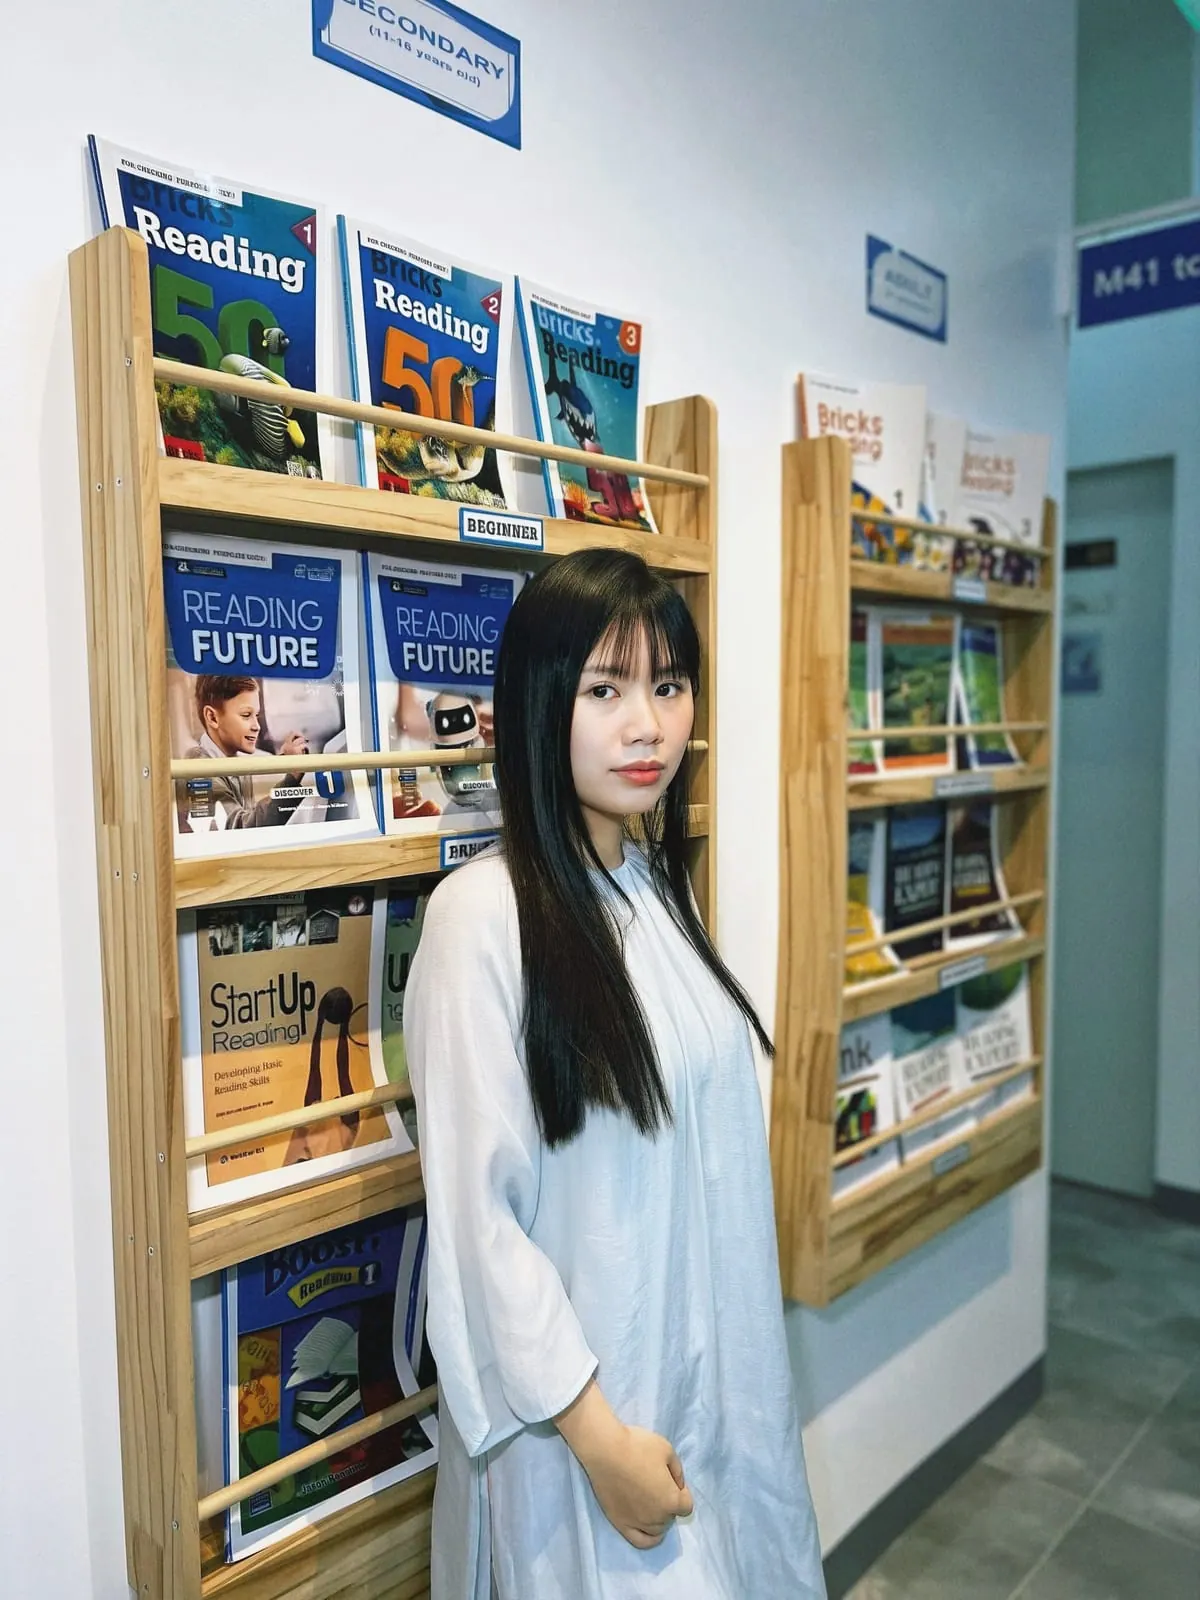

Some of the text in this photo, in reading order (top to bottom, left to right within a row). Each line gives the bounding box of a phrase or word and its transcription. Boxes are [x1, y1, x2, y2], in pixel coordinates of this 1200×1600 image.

[415, 48, 453, 71] years
[456, 69, 481, 88] old)
[121, 158, 136, 170] FOR
[137, 164, 173, 182] CHECKING
[132, 205, 306, 294] Reading
[303, 223, 312, 245] 1
[380, 241, 407, 256] CHECKING
[1093, 256, 1160, 298] M41
[372, 278, 490, 354] Reading
[488, 297, 499, 315] 2
[625, 325, 637, 347] 3
[541, 328, 635, 389] Reading
[818, 402, 883, 436] Bricks
[467, 518, 538, 541] BEGINNER
[183, 589, 323, 632] READING
[396, 606, 499, 644] READING
[191, 629, 319, 668] FUTURE
[402, 642, 495, 676] FUTURE
[274, 788, 314, 797] DISCOVER
[323, 770, 335, 794] 1
[210, 971, 316, 1036] StartUp
[212, 1022, 301, 1054] Reading
[214, 1059, 283, 1082] Developing Basic
[214, 1075, 270, 1095] Reading Skills
[364, 1263, 377, 1286] 1
